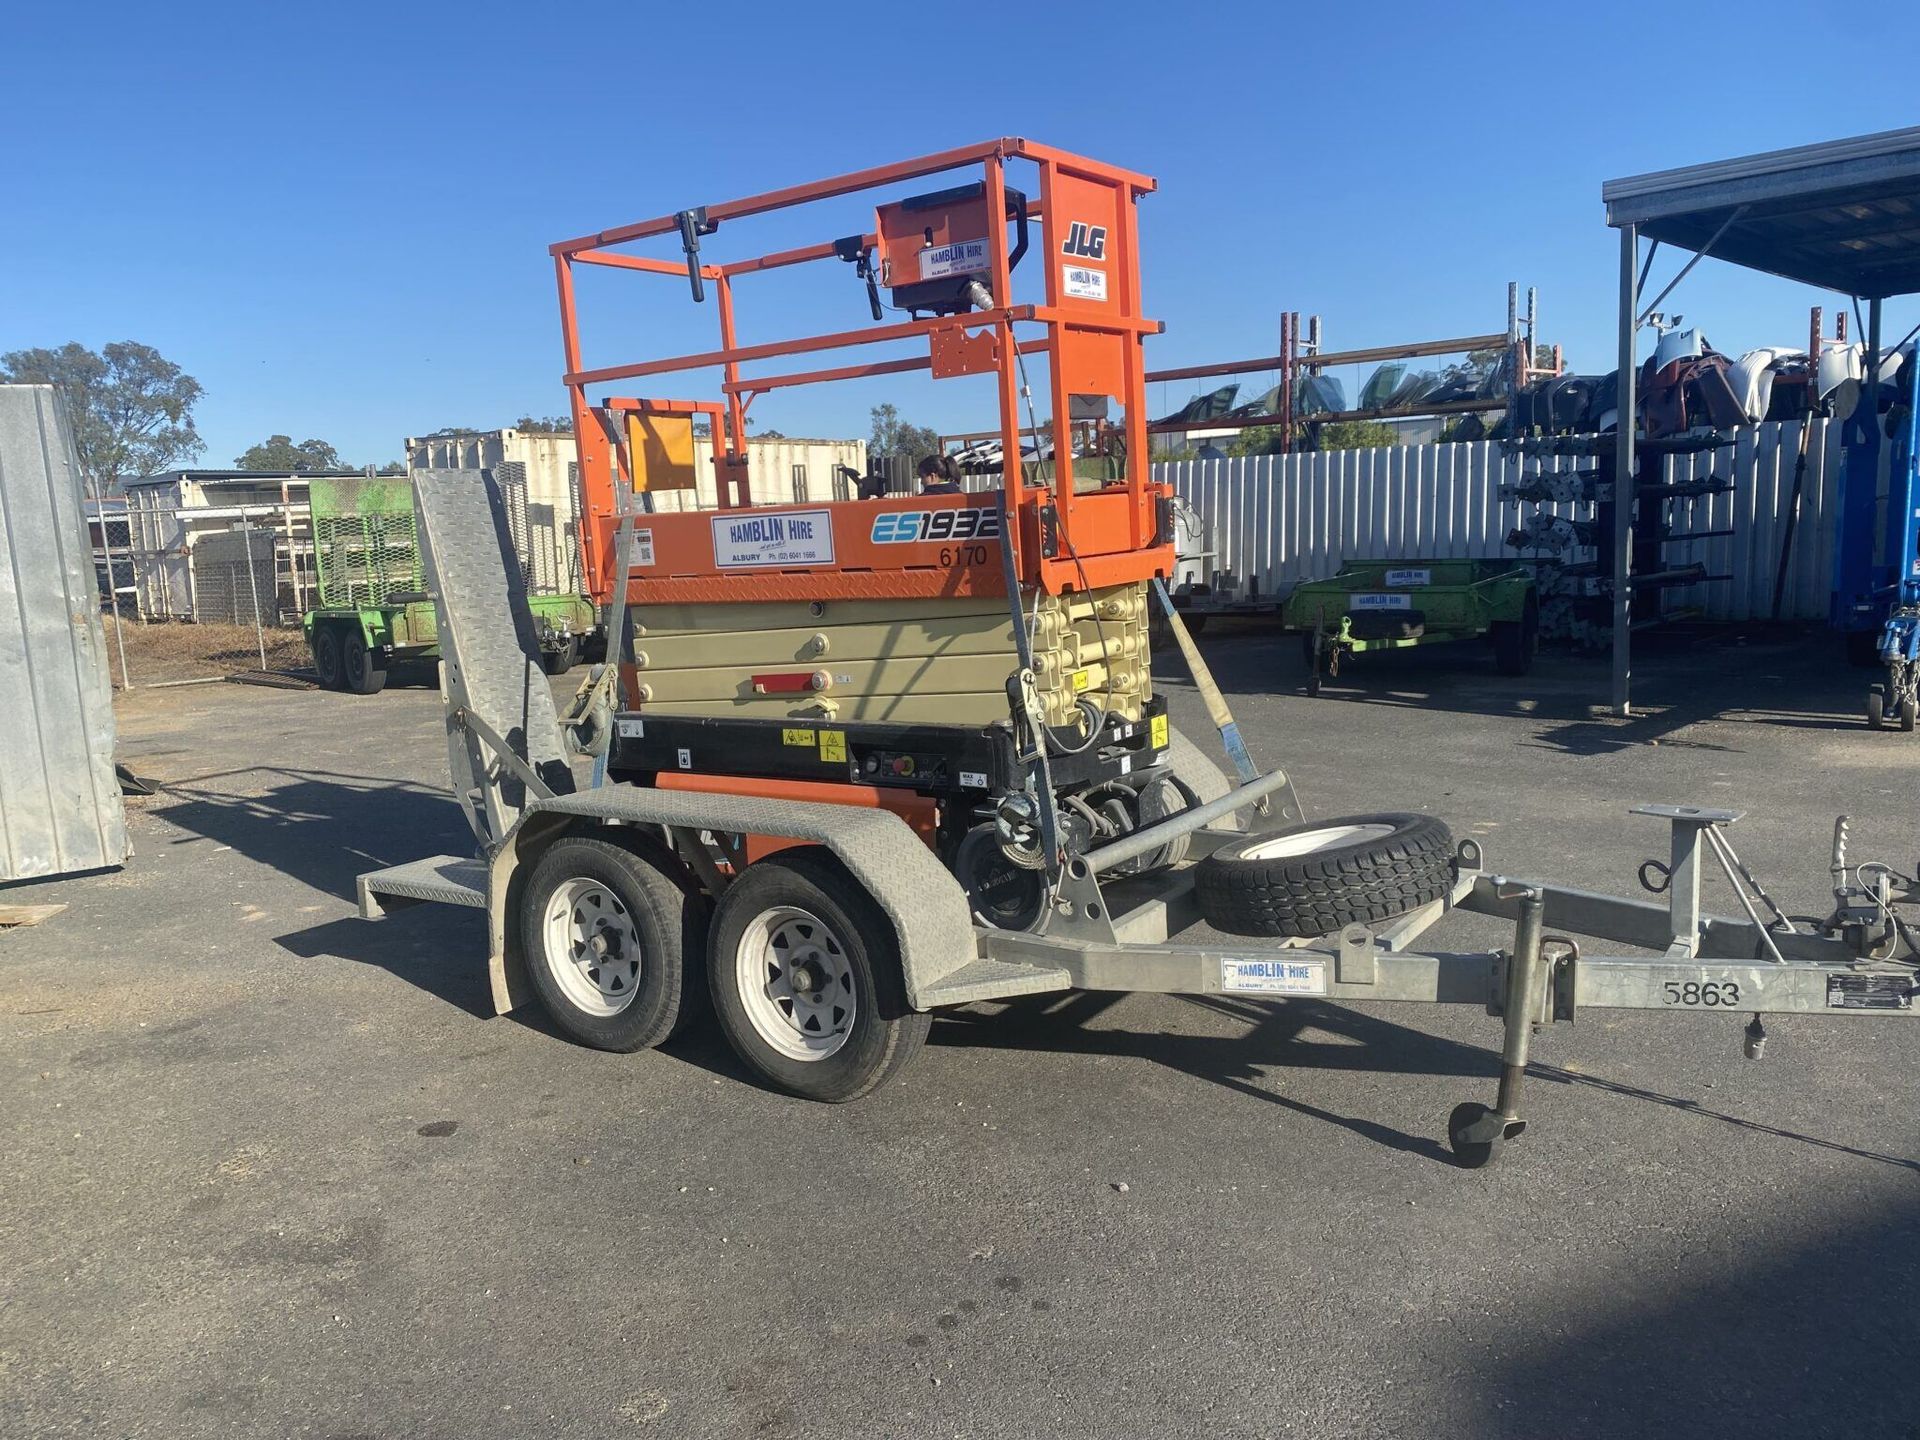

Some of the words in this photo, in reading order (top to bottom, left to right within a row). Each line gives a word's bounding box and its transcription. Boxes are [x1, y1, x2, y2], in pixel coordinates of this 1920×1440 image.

[1063, 223, 1106, 259] JLG
[931, 246, 965, 264] HAMBLIN
[967, 245, 982, 257] HIRE
[730, 518, 784, 543] HAMBLIN
[787, 519, 813, 540] HIRE
[732, 553, 760, 562] ALBURY
[940, 546, 987, 567] 6170
[1238, 963, 1284, 978] HAMBLIN
[1288, 965, 1310, 979] HIRE
[1663, 982, 1740, 1007] 5863
